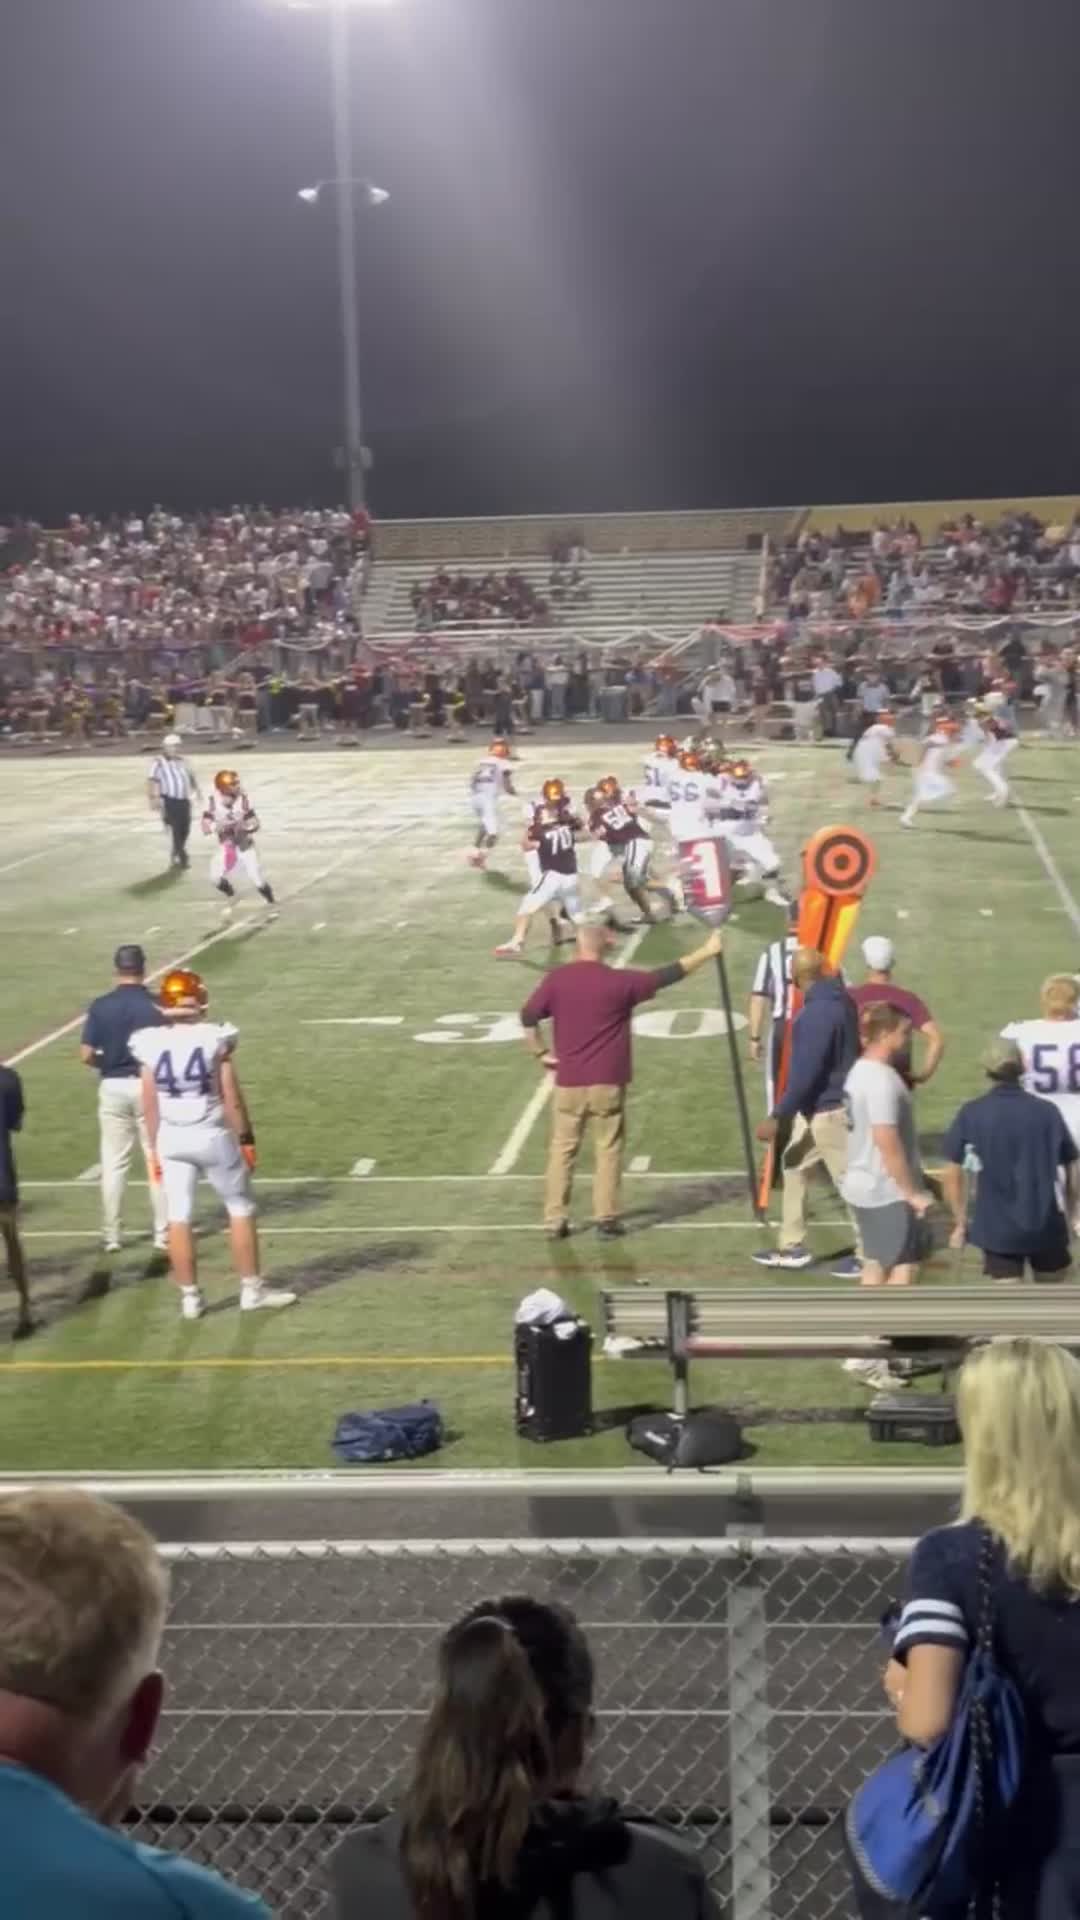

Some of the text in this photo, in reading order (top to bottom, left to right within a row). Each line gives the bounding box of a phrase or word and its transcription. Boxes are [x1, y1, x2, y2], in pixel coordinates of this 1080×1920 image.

[545, 825, 572, 855] 70
[691, 841, 722, 897] 1
[154, 1047, 210, 1098] 44
